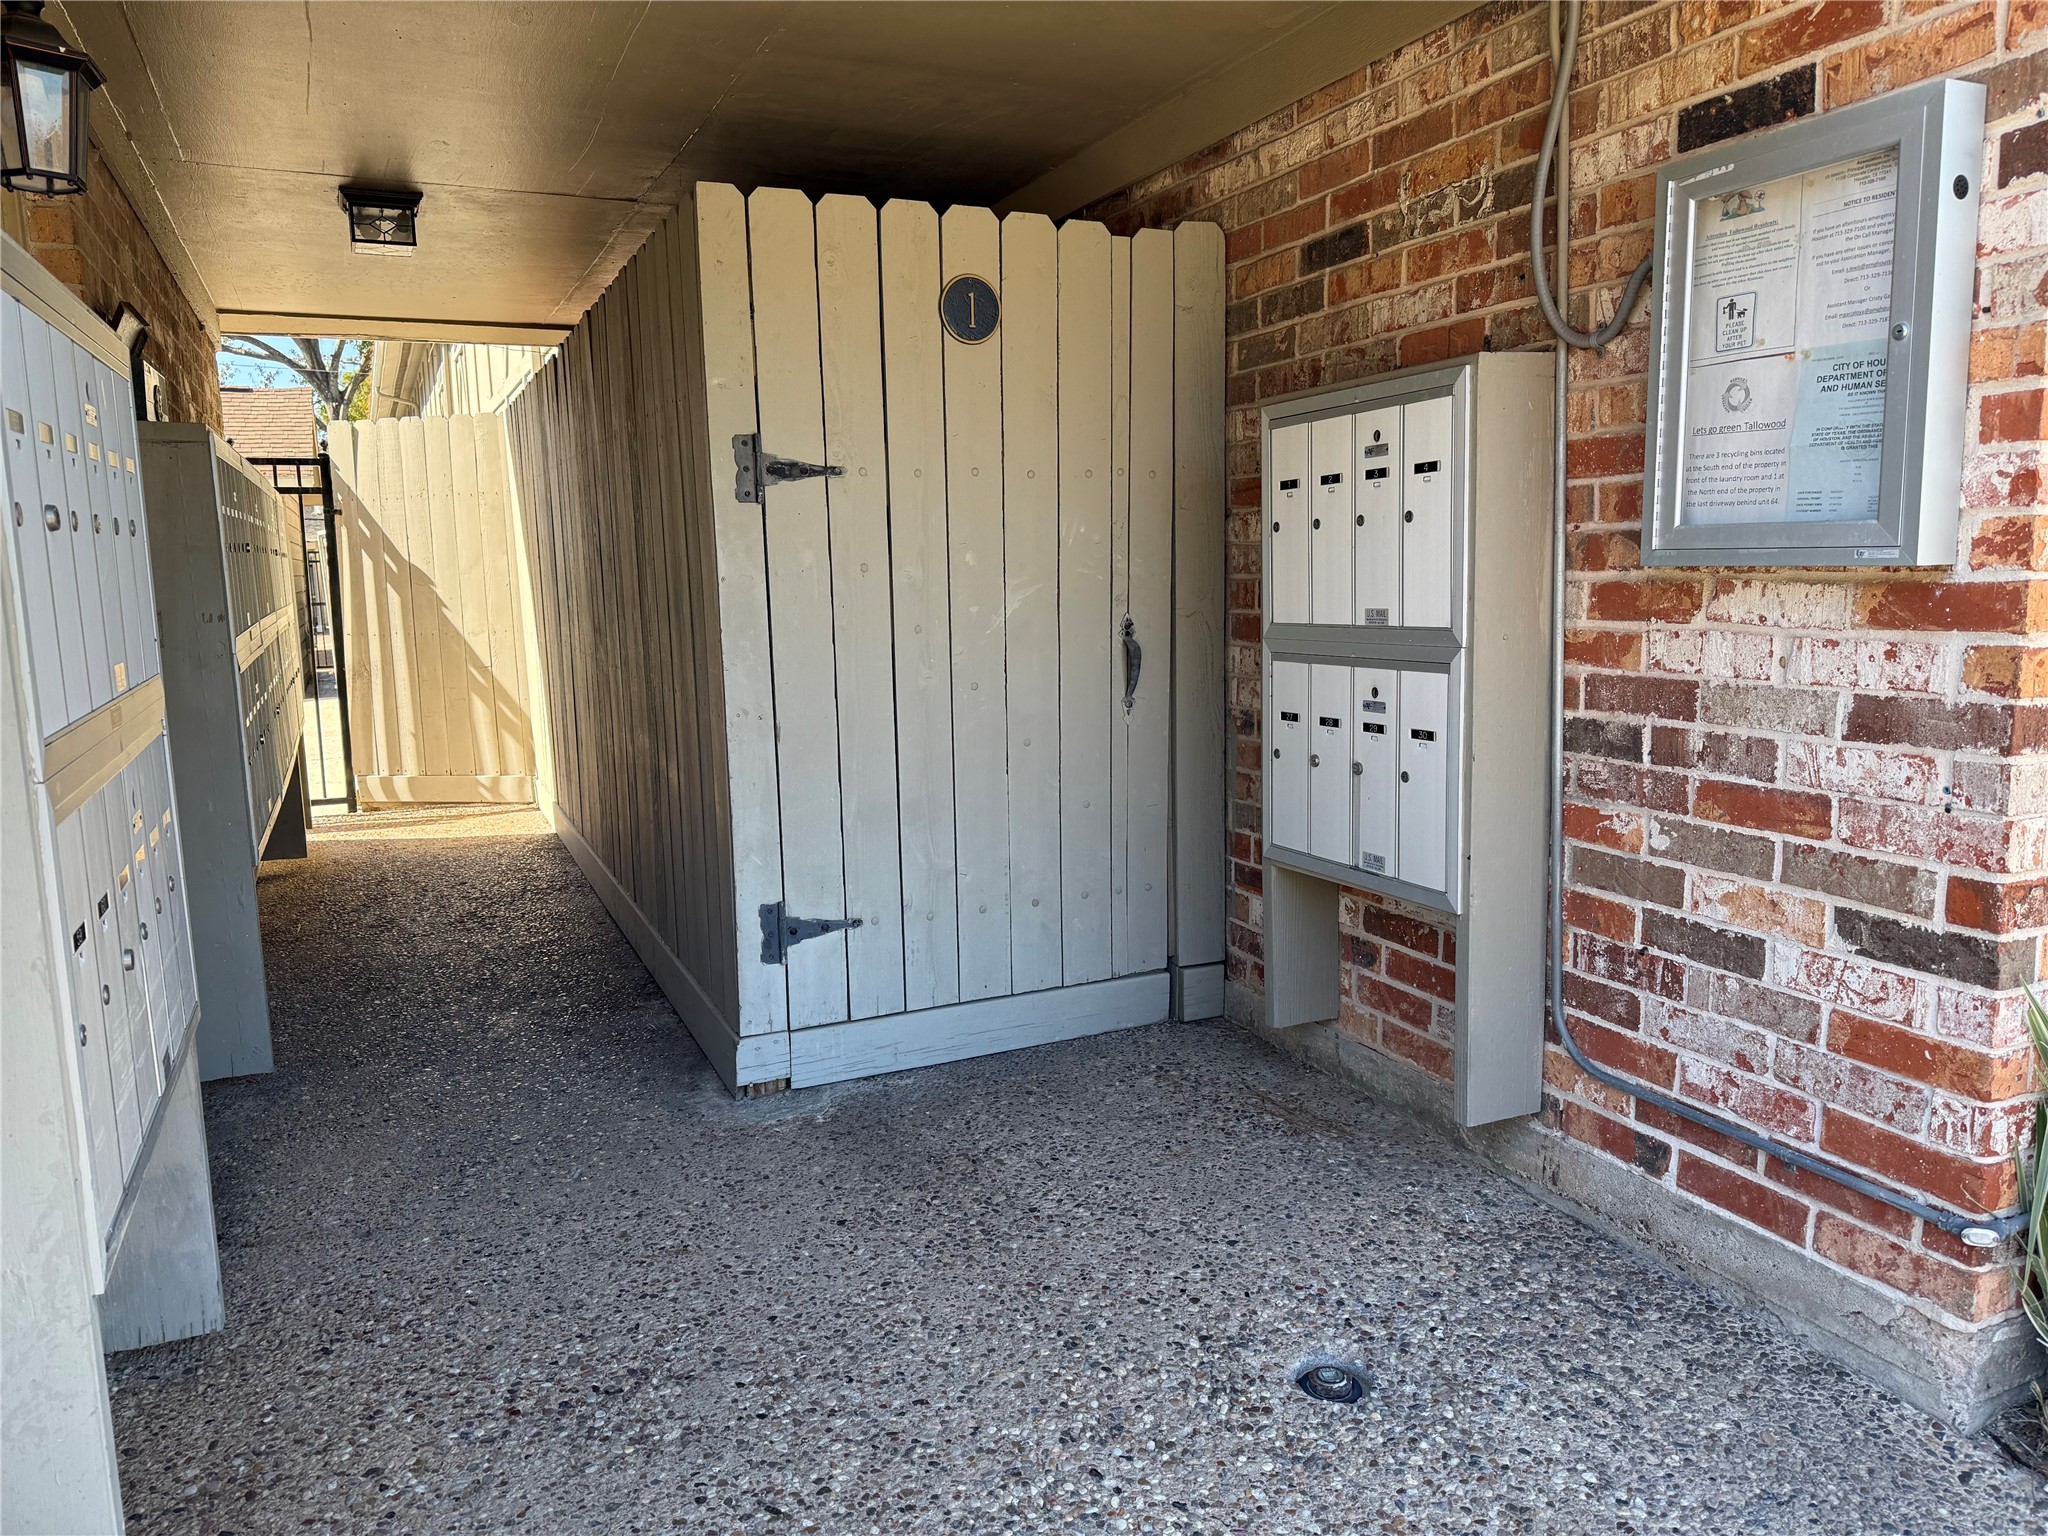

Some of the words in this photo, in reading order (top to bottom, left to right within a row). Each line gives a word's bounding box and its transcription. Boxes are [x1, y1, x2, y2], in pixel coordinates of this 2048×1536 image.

[1843, 198, 1862, 207] NOTICE
[1872, 228, 1894, 236] Manager
[968, 292, 976, 328] 1
[1726, 320, 1744, 328] PLEASE
[1832, 362, 1851, 371] CITY
[1853, 361, 1864, 369] OF
[1867, 358, 1886, 368] HOU
[1816, 370, 1874, 383] DEPARTMENT
[1876, 369, 1887, 377] OF
[1820, 384, 1838, 393] AND
[1841, 381, 1872, 391] HUMAN
[1708, 426, 1718, 435] go
[1718, 424, 1742, 435] green
[1744, 418, 1787, 430] Tallowood
[1423, 464, 1429, 472] 4
[1418, 730, 1428, 739] 30
